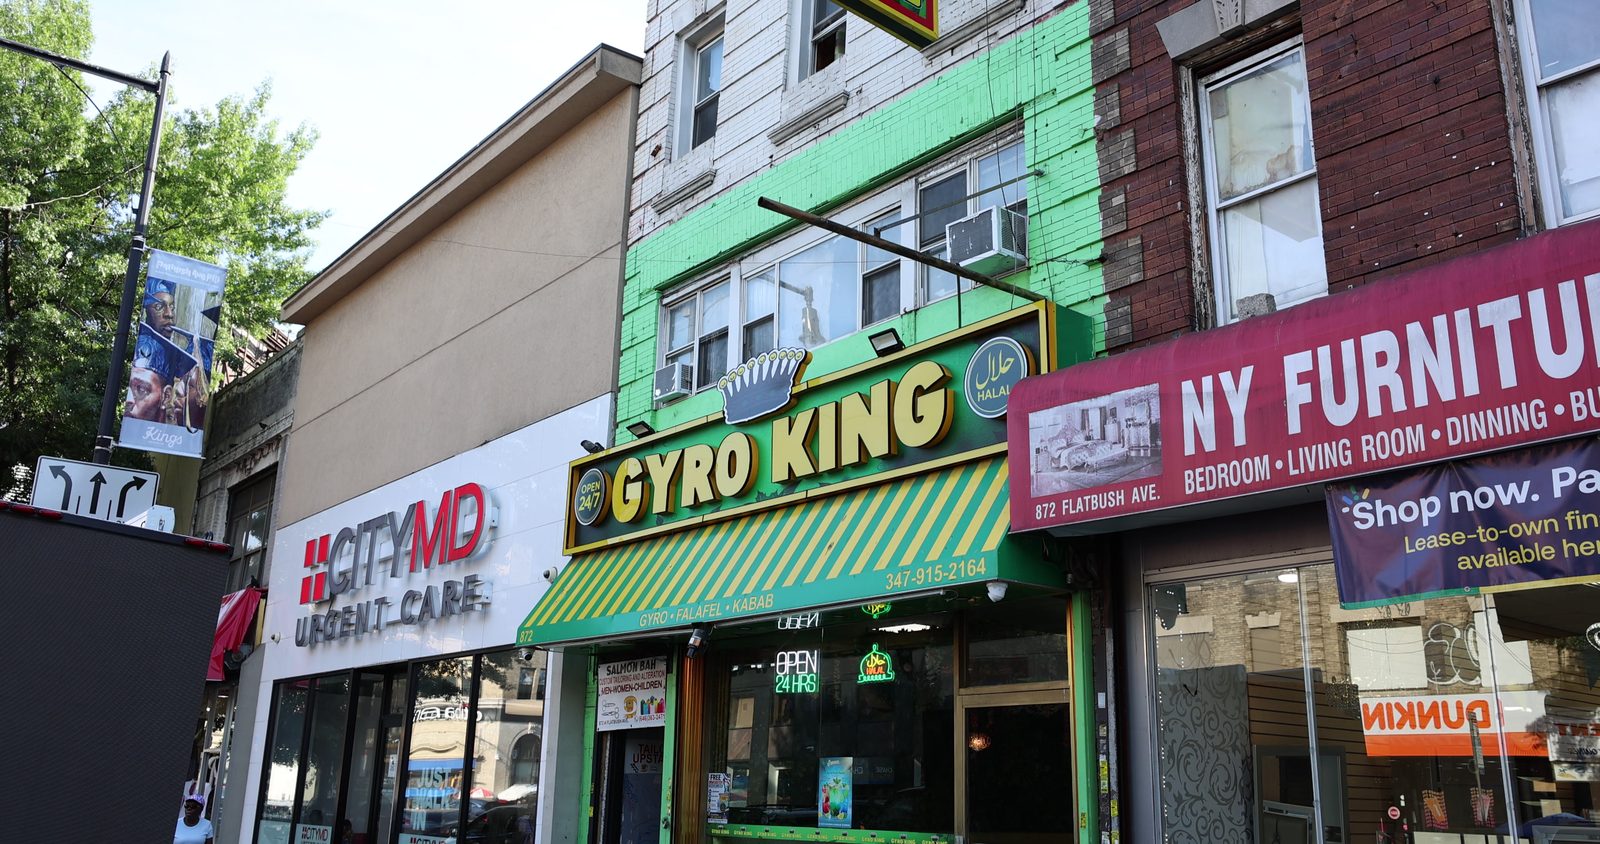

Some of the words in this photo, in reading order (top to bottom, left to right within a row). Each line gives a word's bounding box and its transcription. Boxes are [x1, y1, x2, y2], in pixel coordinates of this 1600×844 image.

[976, 350, 1014, 390] حلال
[977, 384, 1010, 402] HALAL
[1181, 364, 1254, 456] NY
[142, 426, 182, 448] Kings
[612, 432, 754, 523] GYRO
[772, 360, 951, 484] KING
[1184, 454, 1270, 495] BEDROOM
[1288, 438, 1352, 476] LIVING
[1361, 423, 1426, 462] ROOM
[1446, 398, 1548, 446] DINNING
[582, 480, 600, 494] OPEN
[578, 492, 600, 512] 24/7
[1036, 502, 1056, 520] 872
[1062, 489, 1125, 516] FLATBUSH
[1132, 484, 1160, 504] AVE.
[1352, 494, 1441, 530] Shop
[1450, 480, 1540, 514] now.
[328, 482, 488, 595] CITYMD
[1404, 516, 1559, 554] Lease-to-own
[1565, 510, 1600, 530] fin
[1457, 542, 1556, 571] available
[886, 557, 986, 590] 347-915-2164
[295, 597, 388, 647] URGENT
[401, 574, 484, 625] CARE
[639, 612, 668, 628] GYRO
[676, 604, 722, 622] FALAFEL
[732, 594, 774, 613] KABAB
[520, 630, 534, 643] 872
[606, 661, 638, 676] SALMON
[640, 659, 656, 672] BAH
[776, 650, 817, 674] OPEN
[642, 670, 665, 680] ALTERATION
[776, 675, 790, 693] 24
[792, 674, 816, 693] HRS
[638, 744, 663, 754] TAIL
[416, 768, 452, 788] JUST
[411, 788, 454, 810] WALK
[411, 810, 426, 830] IN
